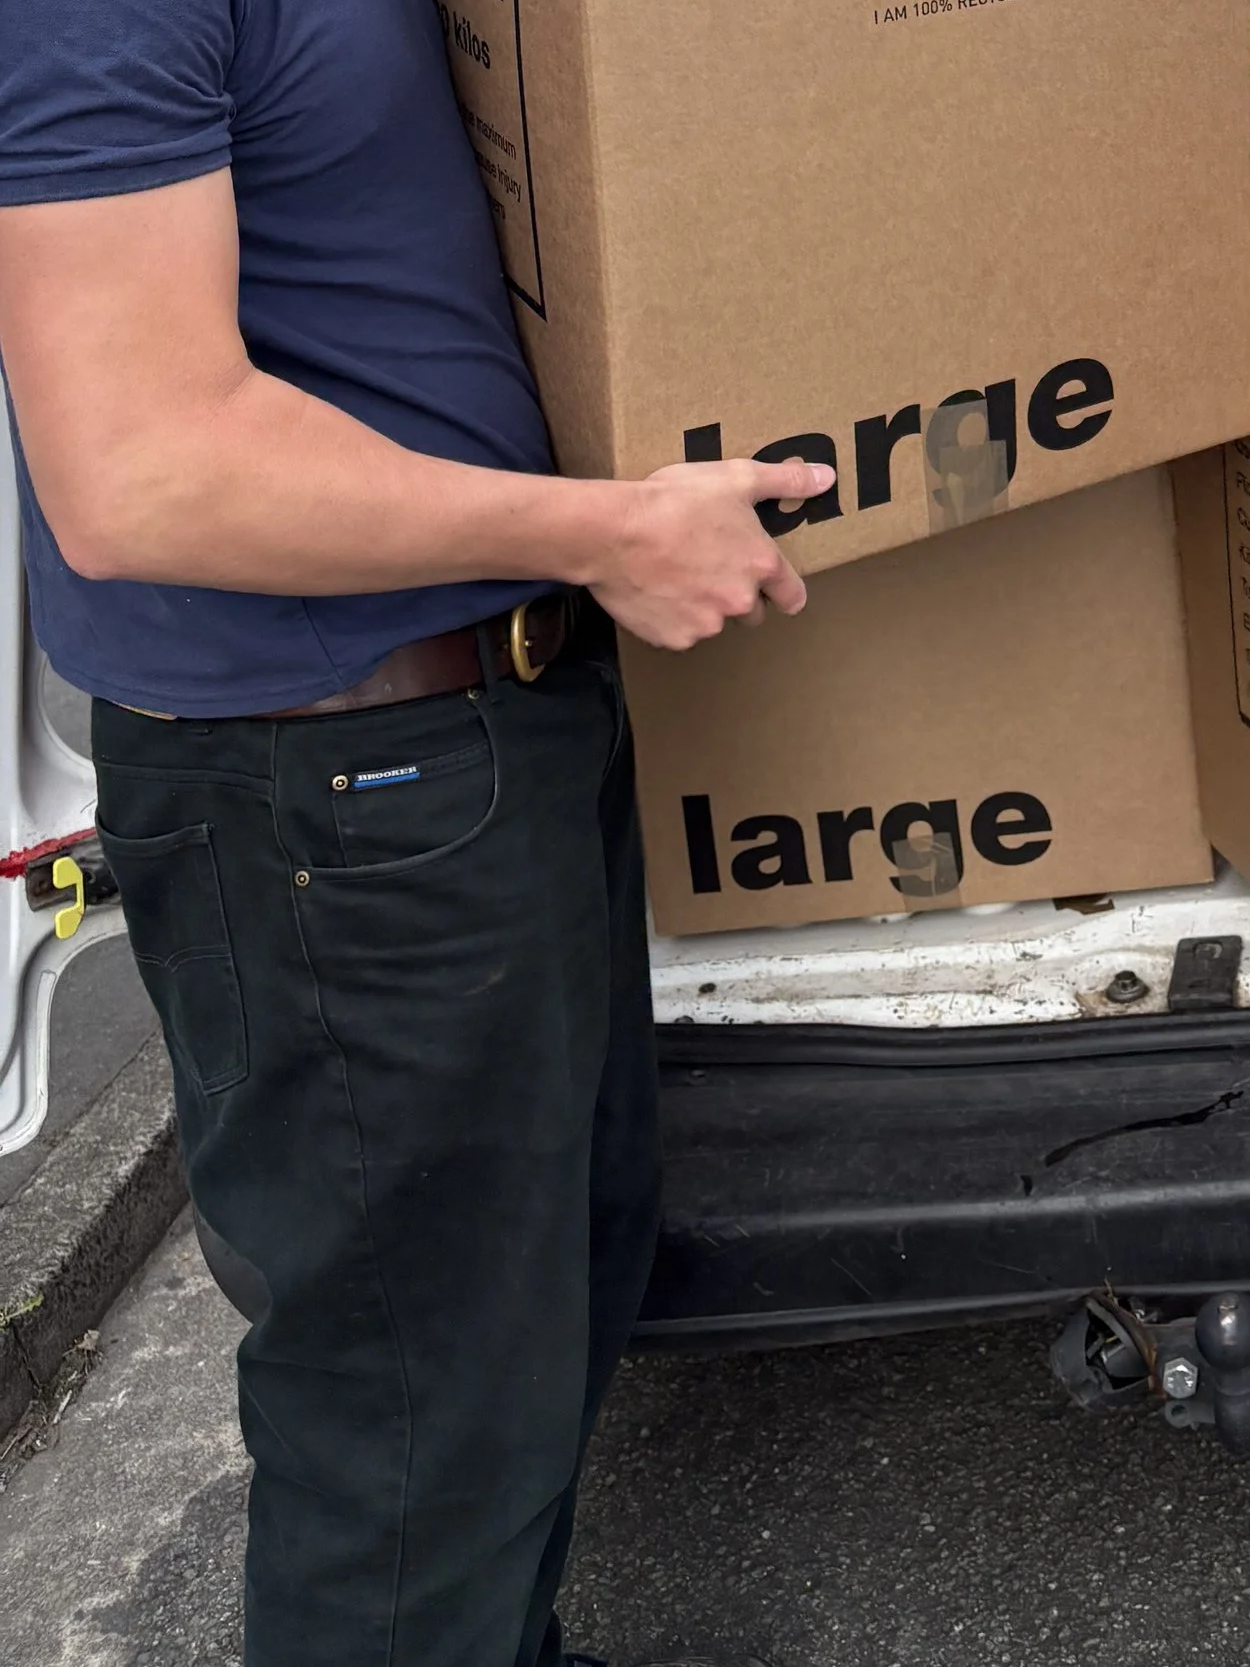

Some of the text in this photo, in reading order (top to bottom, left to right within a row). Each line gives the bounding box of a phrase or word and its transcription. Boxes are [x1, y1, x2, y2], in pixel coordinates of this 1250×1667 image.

[873, 9, 879, 25] I
[883, 5, 907, 24] AM
[453, 10, 491, 70] kilos
[356, 766, 418, 782] BROOKER
[681, 791, 1053, 898] large
